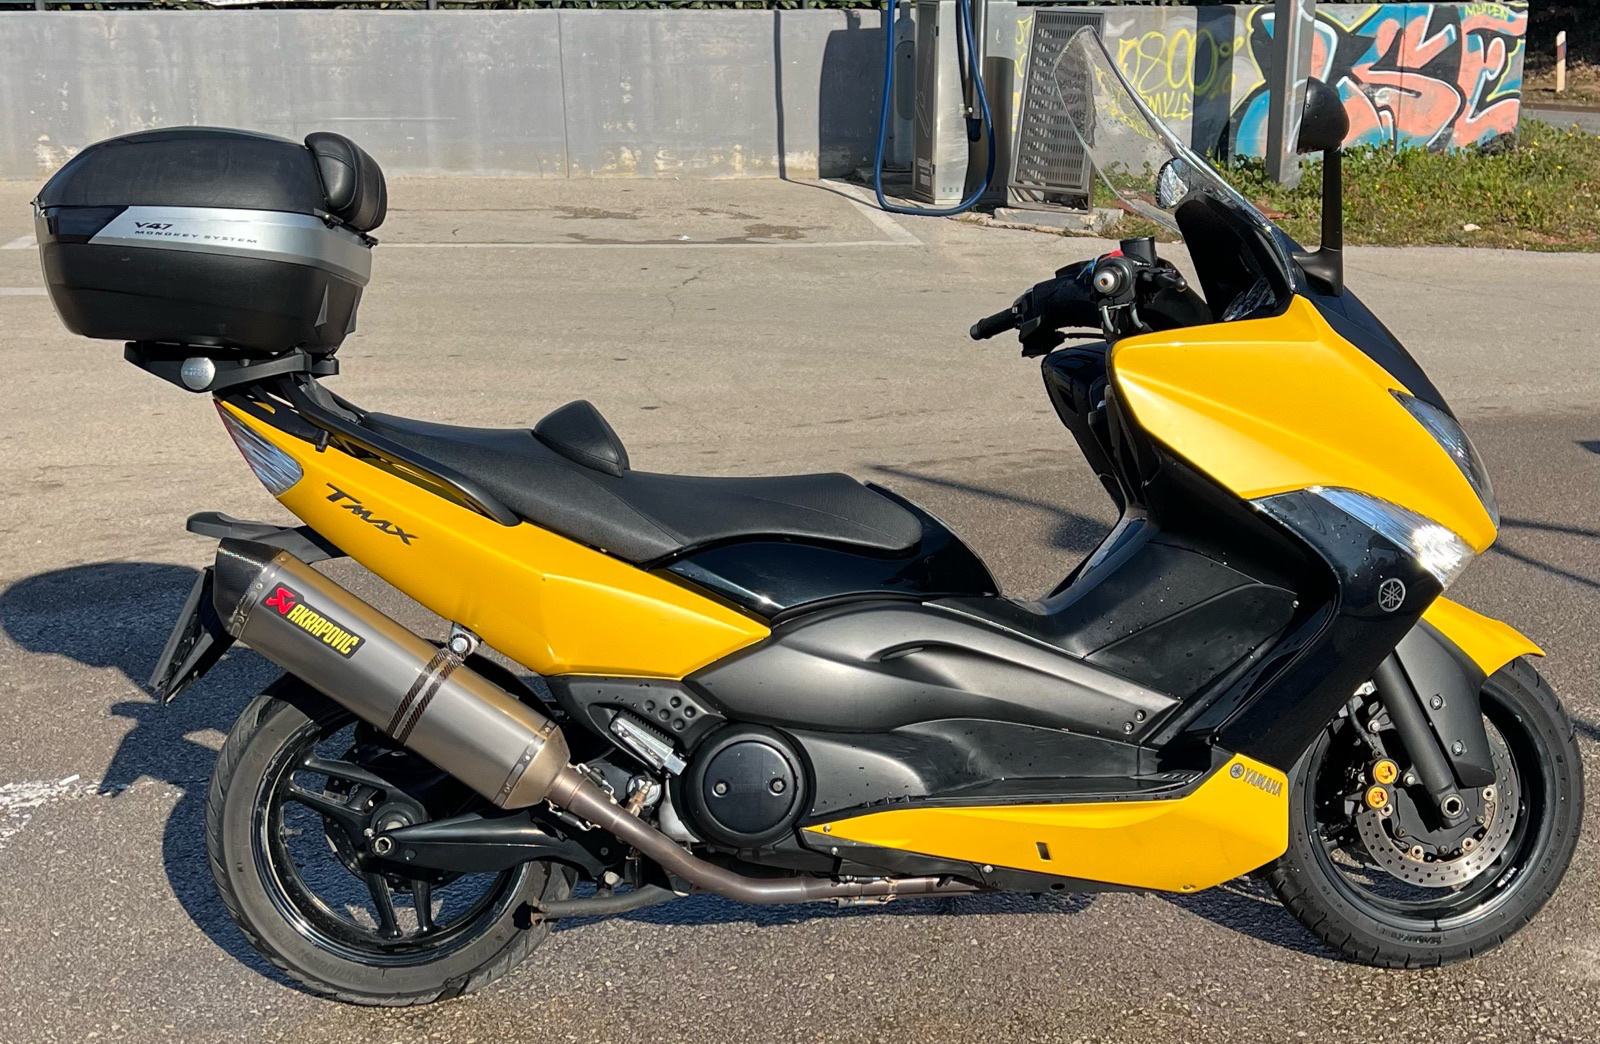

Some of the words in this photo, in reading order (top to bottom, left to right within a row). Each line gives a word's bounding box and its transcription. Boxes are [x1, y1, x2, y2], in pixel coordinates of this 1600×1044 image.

[134, 221, 174, 231] V47
[134, 230, 199, 239] MONOKEY
[203, 234, 258, 244] SYSTEM
[1242, 767, 1283, 798] YAMAHA
